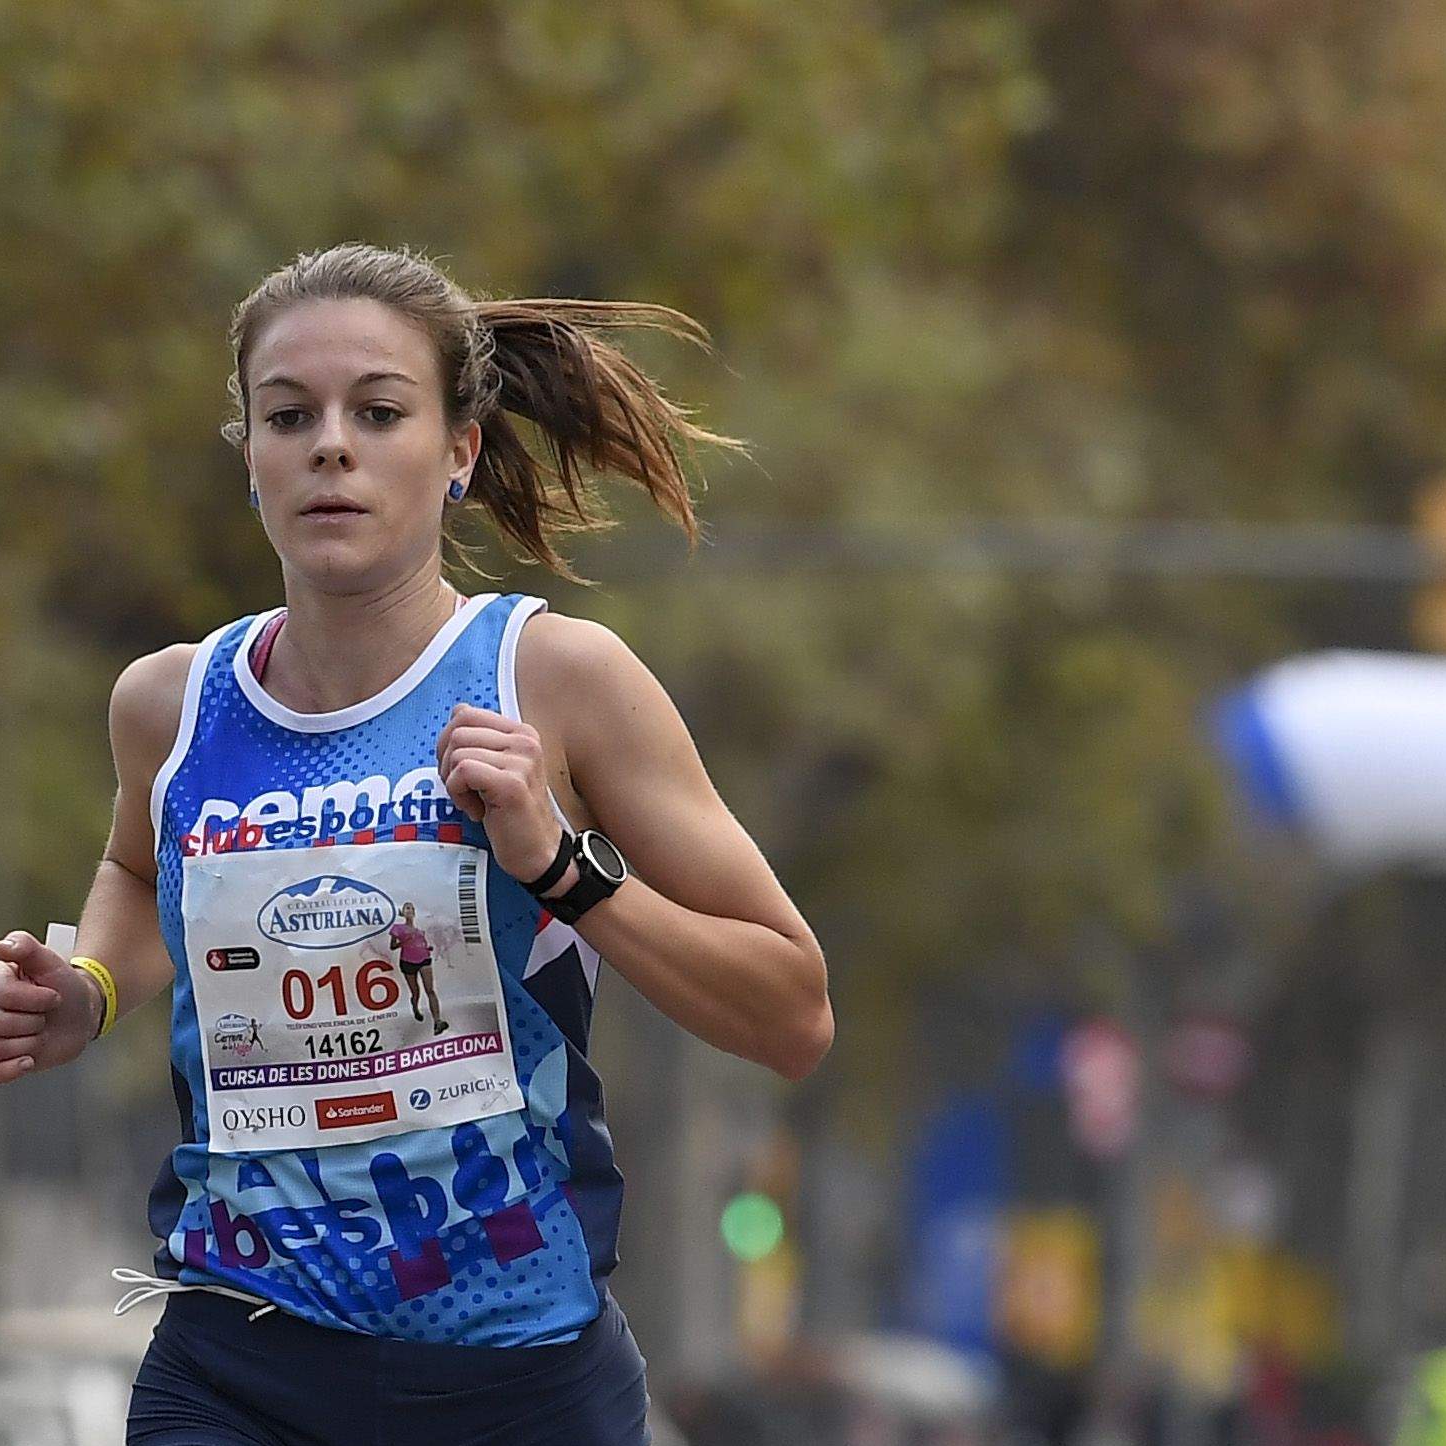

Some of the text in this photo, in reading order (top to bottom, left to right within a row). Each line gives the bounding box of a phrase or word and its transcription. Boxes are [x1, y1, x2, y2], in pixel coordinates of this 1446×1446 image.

[282, 960, 400, 1020] 016
[305, 1028, 383, 1059] 14162
[218, 1035, 499, 1087] CURSA DE LES DONES DE BARCELONA
[438, 1079, 496, 1100] ZURICH
[222, 1104, 306, 1131] OYSHO
[337, 1102, 385, 1118] Santander
